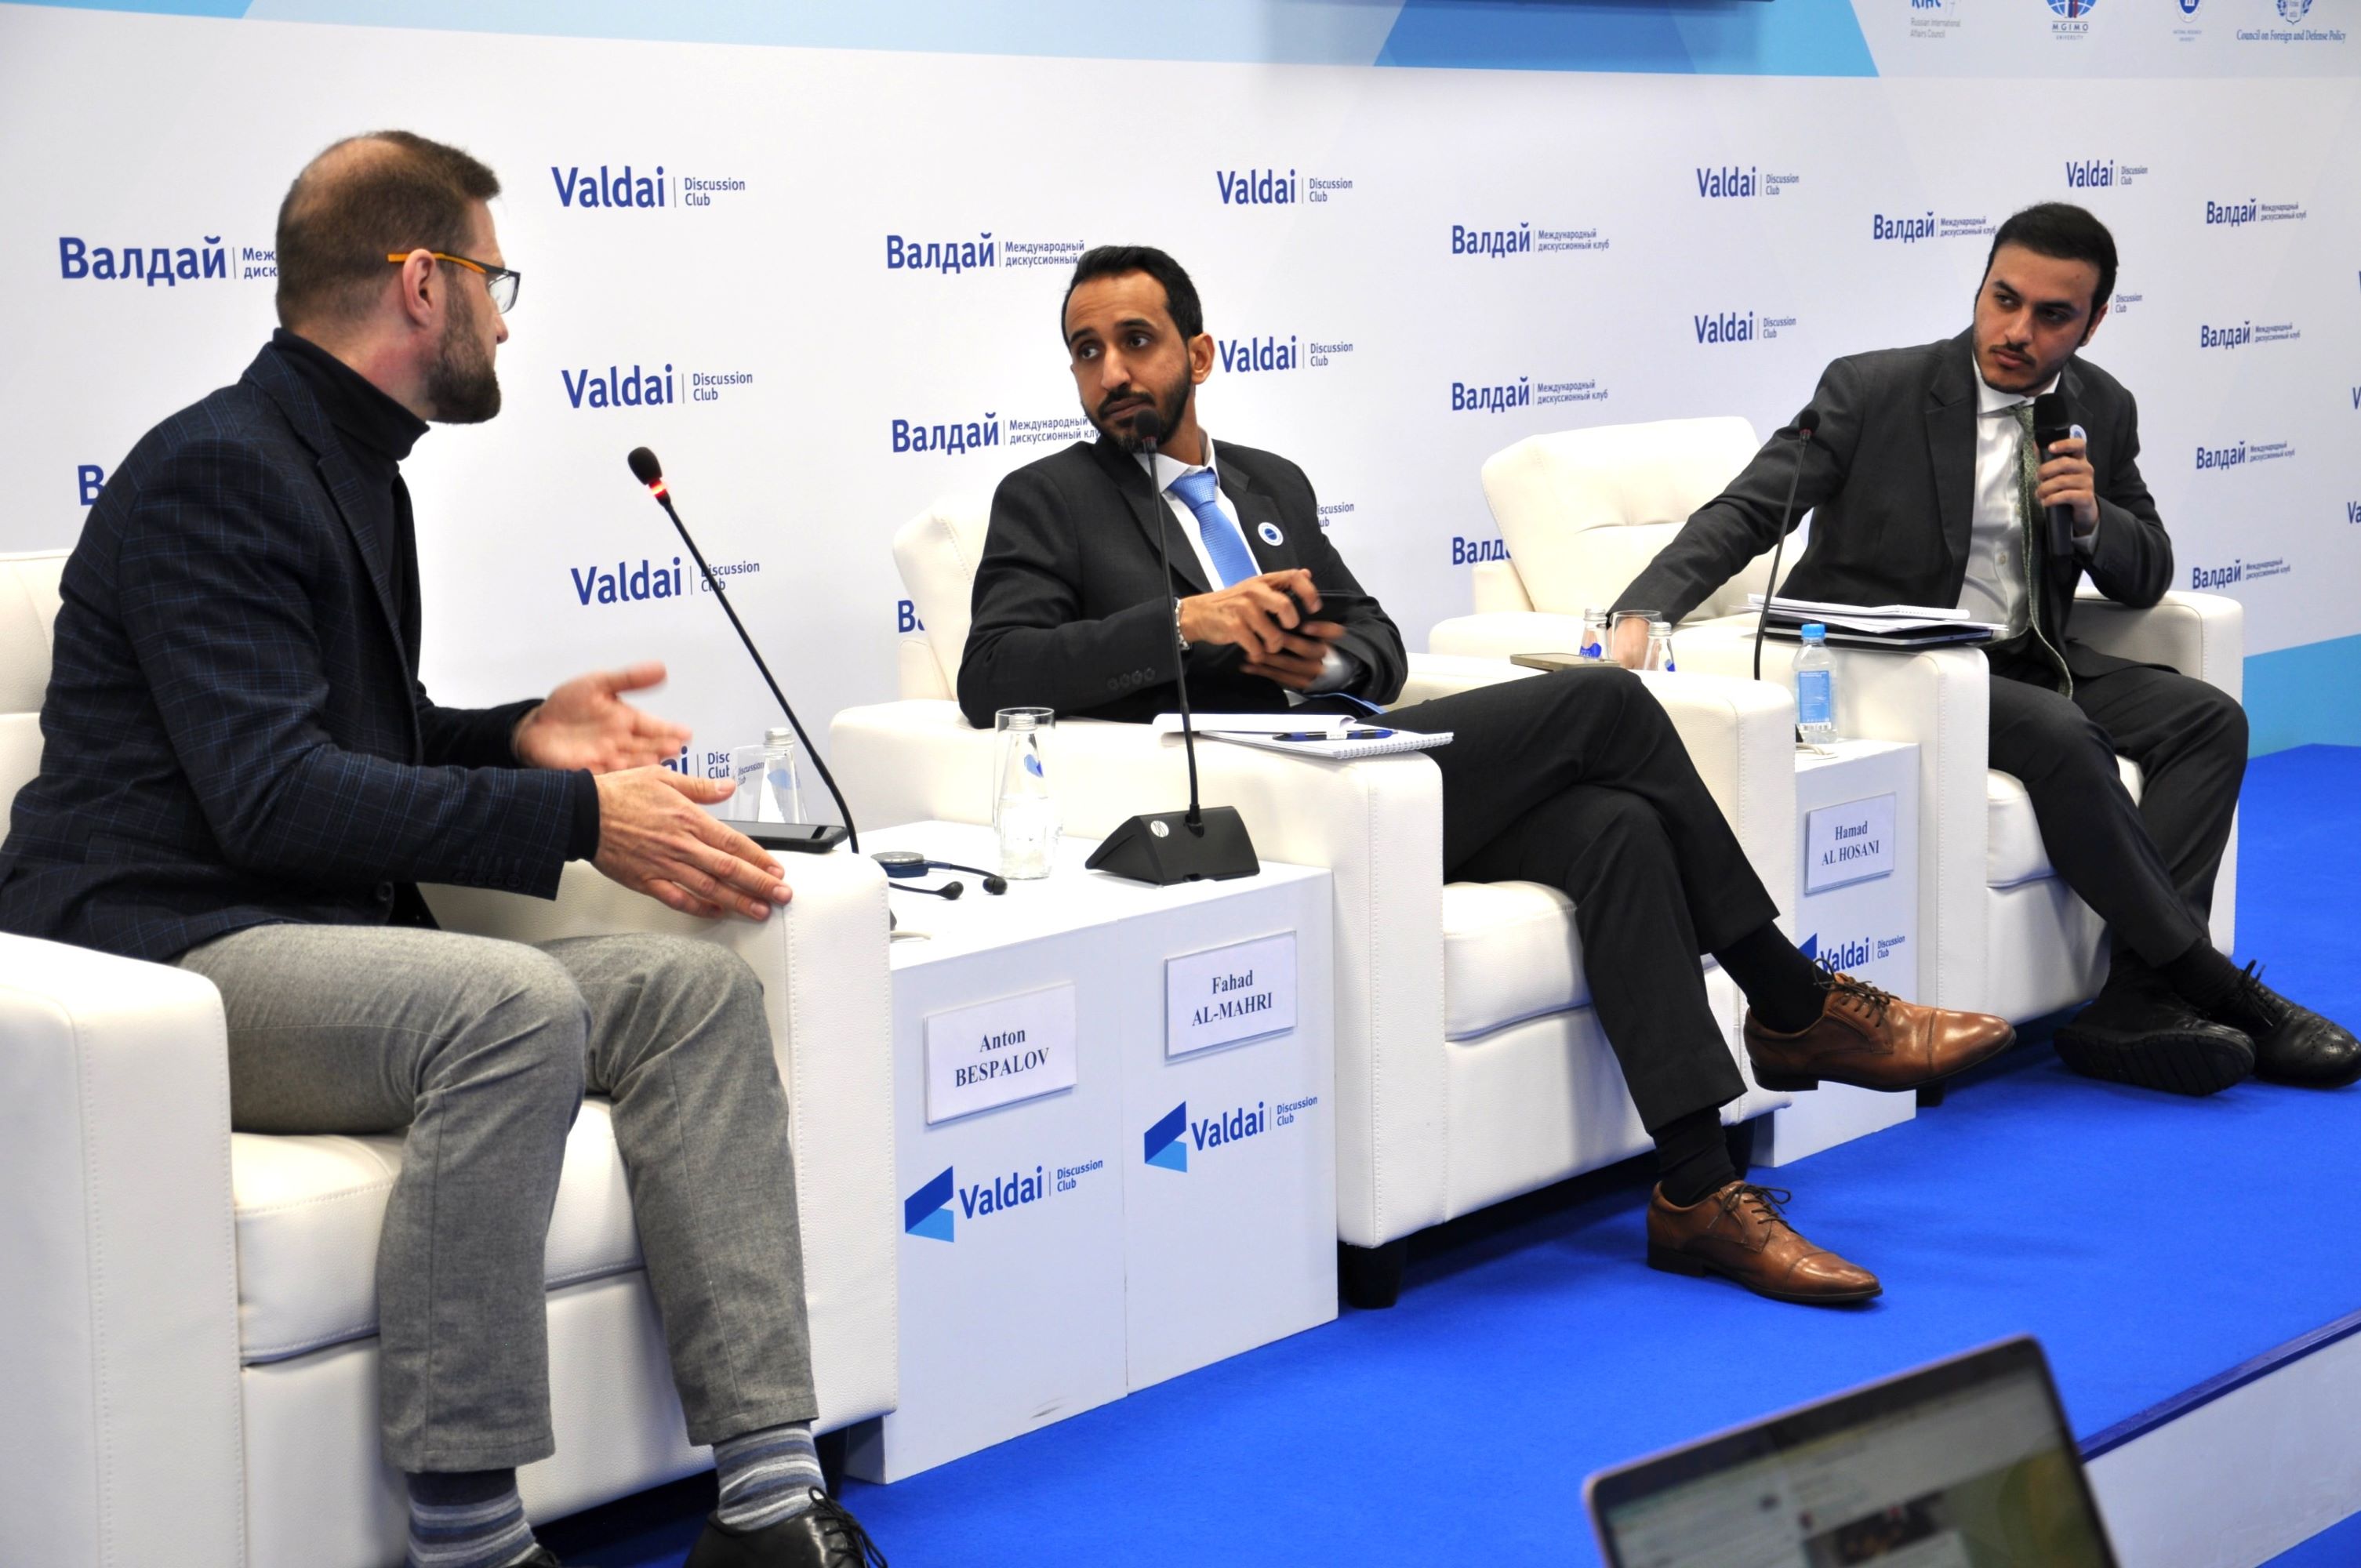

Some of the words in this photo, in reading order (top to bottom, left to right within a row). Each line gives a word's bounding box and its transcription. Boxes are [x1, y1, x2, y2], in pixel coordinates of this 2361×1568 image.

[2052, 23, 2089, 31] MGIMO
[685, 177, 746, 191] Discussion
[1309, 177, 1353, 189] Discussion
[1697, 166, 1756, 198] Valdai
[2066, 160, 2113, 187] Valdai
[551, 165, 665, 208] Valdai
[1217, 169, 1295, 205] Valdai
[1309, 191, 1328, 202] Club
[685, 193, 710, 206] Club
[2207, 198, 2256, 227] Валдай
[1873, 212, 1934, 243] Валдай
[1005, 240, 1084, 255] Международный
[1452, 222, 1531, 258] Валдай
[1593, 239, 1609, 251] клуб
[59, 236, 227, 286] Валдай
[887, 232, 994, 274] Валдай
[1005, 253, 1078, 267] дискуссионный
[1694, 311, 1753, 343] Valdai
[2201, 321, 2250, 350] Валдай
[1218, 336, 1296, 372] Valdai
[1310, 341, 1353, 354] Discussion
[1310, 355, 1328, 367] Club
[561, 364, 673, 408] Valdai
[692, 372, 753, 386] Discussion
[693, 388, 718, 401] Club
[1452, 376, 1529, 413] Валдай
[1592, 389, 1608, 402] клуб
[892, 412, 998, 455] Валдай
[1009, 415, 1088, 431] Международный
[1010, 428, 1081, 445] дискуссионный
[1084, 430, 1100, 441] клу
[2196, 441, 2246, 470] Валдай
[1317, 502, 1354, 515] iscussion
[1453, 536, 1511, 565] Валд
[571, 557, 681, 605] Valdai
[701, 578, 726, 592] Clb
[2192, 559, 2241, 590] Валдай
[1835, 821, 1868, 840] Hamad
[1822, 850, 1836, 866] AL
[1840, 840, 1880, 862] HOSANI
[1877, 935, 1905, 949] Discussion
[1877, 949, 1889, 959] Club
[1821, 937, 1869, 973] Valdai
[1211, 970, 1253, 994] Fahad
[1192, 992, 1273, 1026] AL-MAHRI
[979, 1029, 1026, 1052] Anton
[955, 1047, 1049, 1087] BESPALOV
[1277, 1095, 1317, 1115] Discussion
[1191, 1101, 1264, 1151] Valdai
[1277, 1113, 1294, 1127] Club
[1057, 1159, 1103, 1180] Discussion
[960, 1166, 1043, 1219] Valdai
[1057, 1178, 1077, 1192] Club
